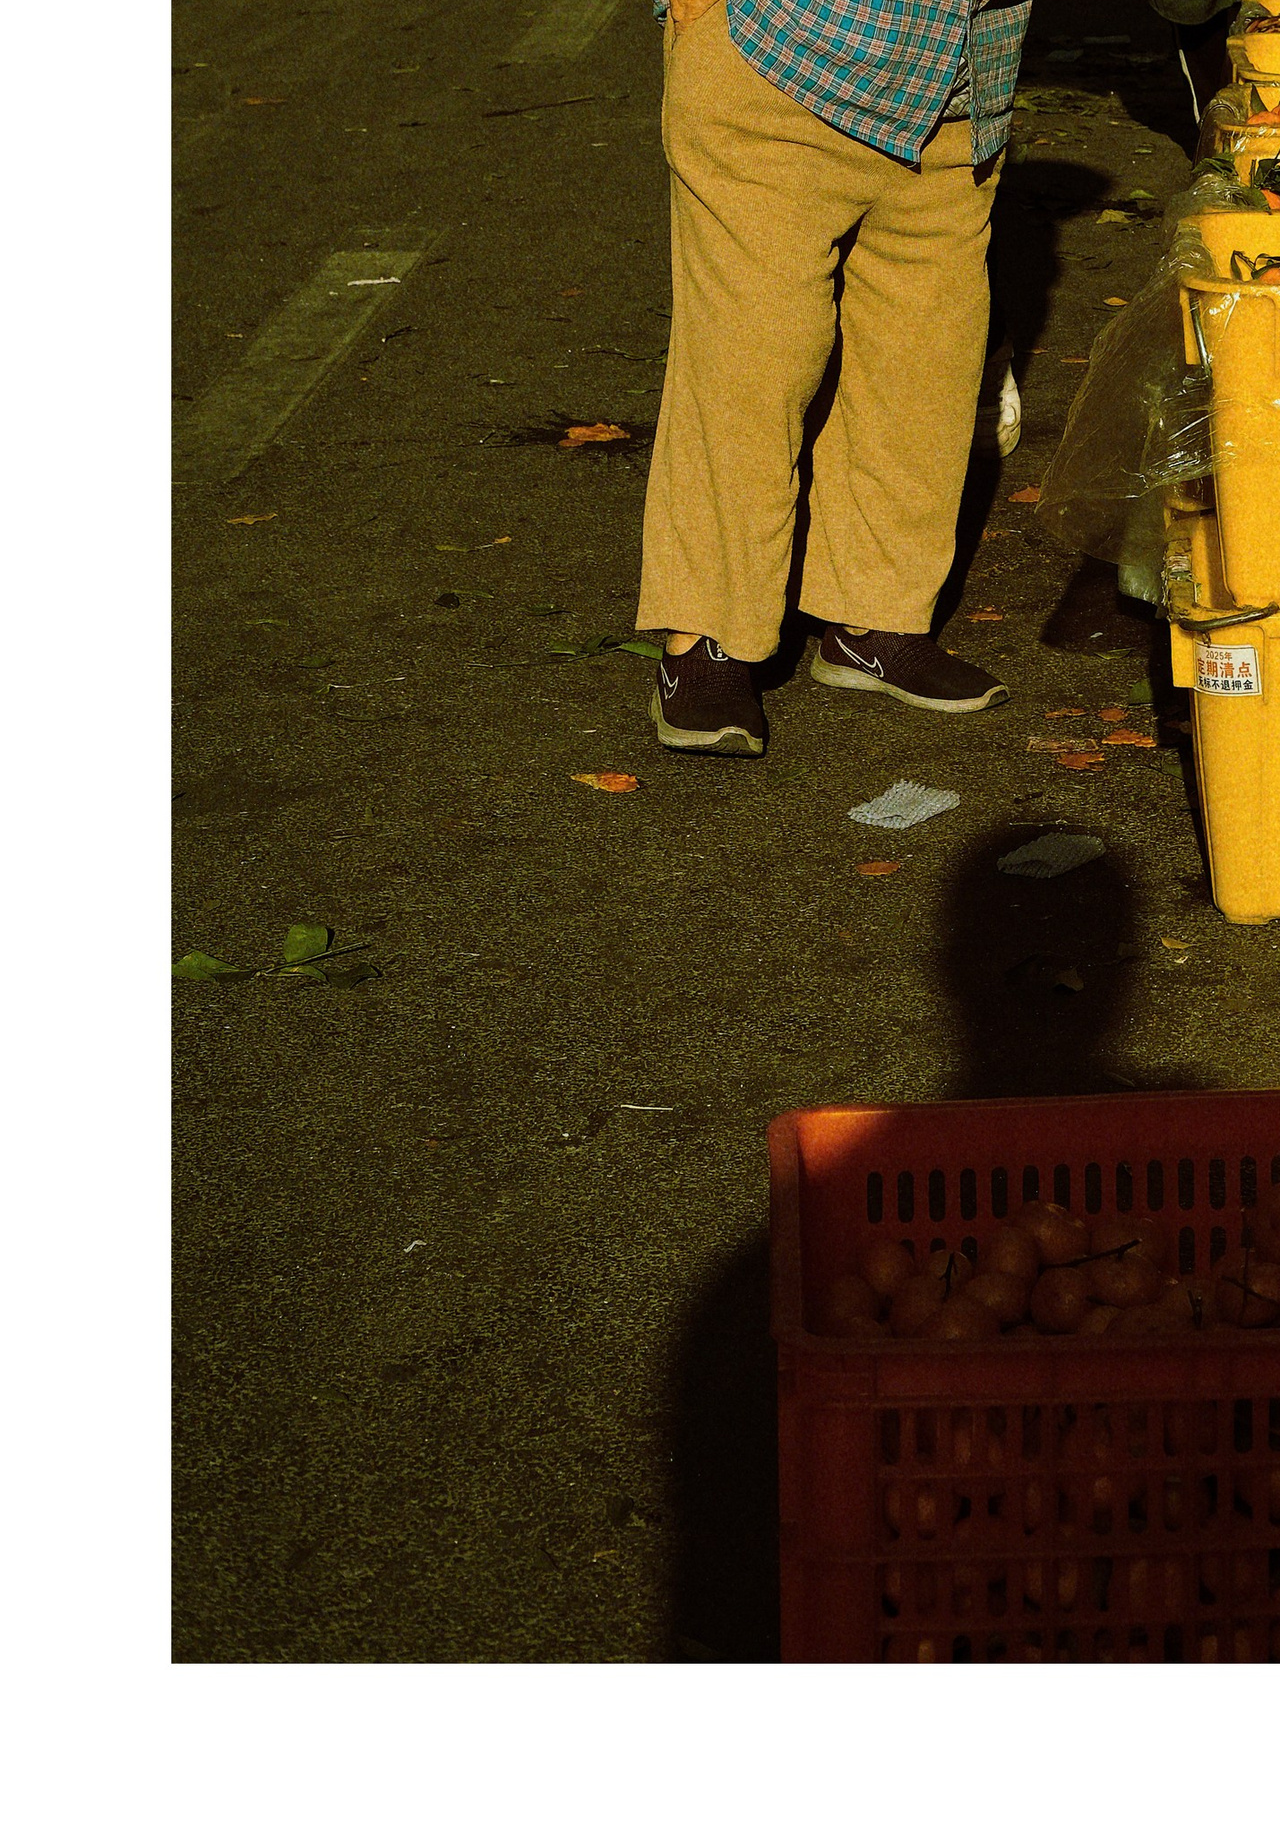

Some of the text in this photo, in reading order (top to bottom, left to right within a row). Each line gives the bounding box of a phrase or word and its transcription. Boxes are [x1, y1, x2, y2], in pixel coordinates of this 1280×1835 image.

[1205, 650, 1233, 661] 2025年
[1197, 657, 1253, 679] 定期清点
